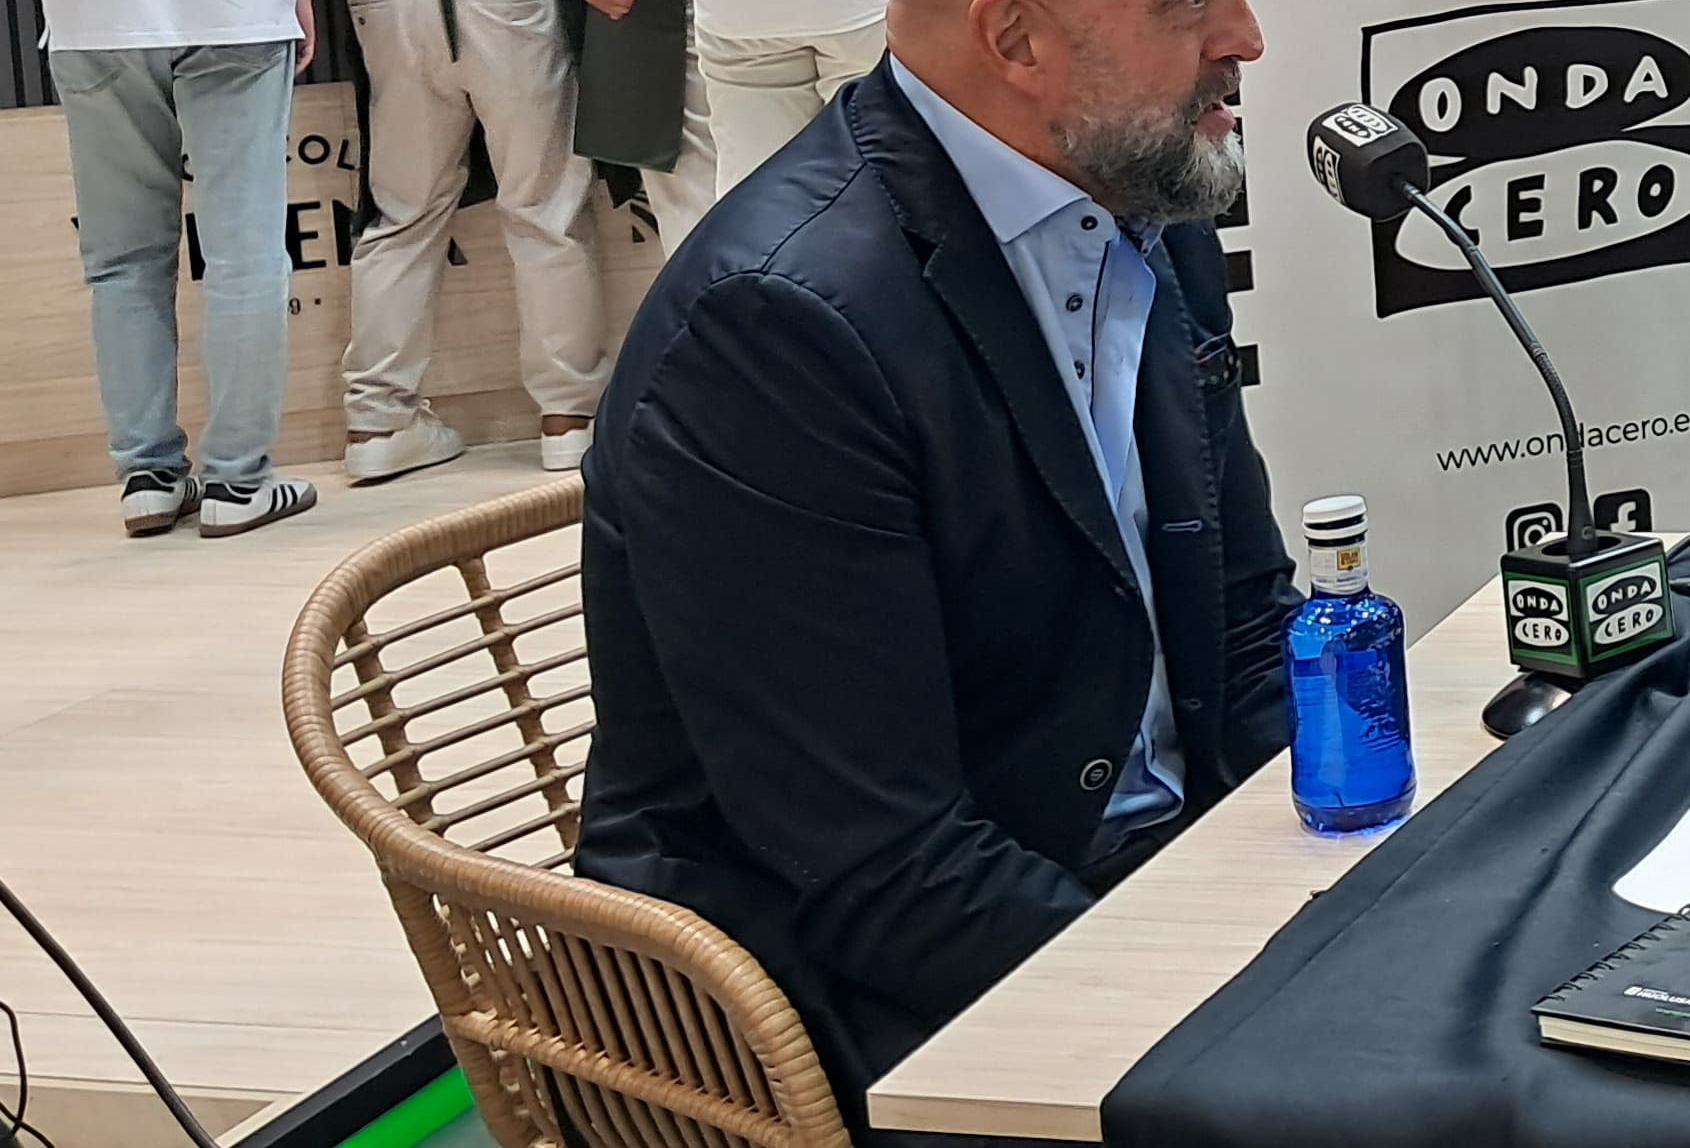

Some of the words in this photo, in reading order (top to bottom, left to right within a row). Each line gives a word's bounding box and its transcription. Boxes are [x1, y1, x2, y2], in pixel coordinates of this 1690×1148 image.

[1419, 55, 1668, 133] ONDA
[1443, 164, 1675, 248] CERO
[1516, 595, 1559, 611] ONDA
[1597, 580, 1651, 609] ONDA
[1522, 623, 1562, 640] CERO
[1604, 609, 1655, 637] CERO
